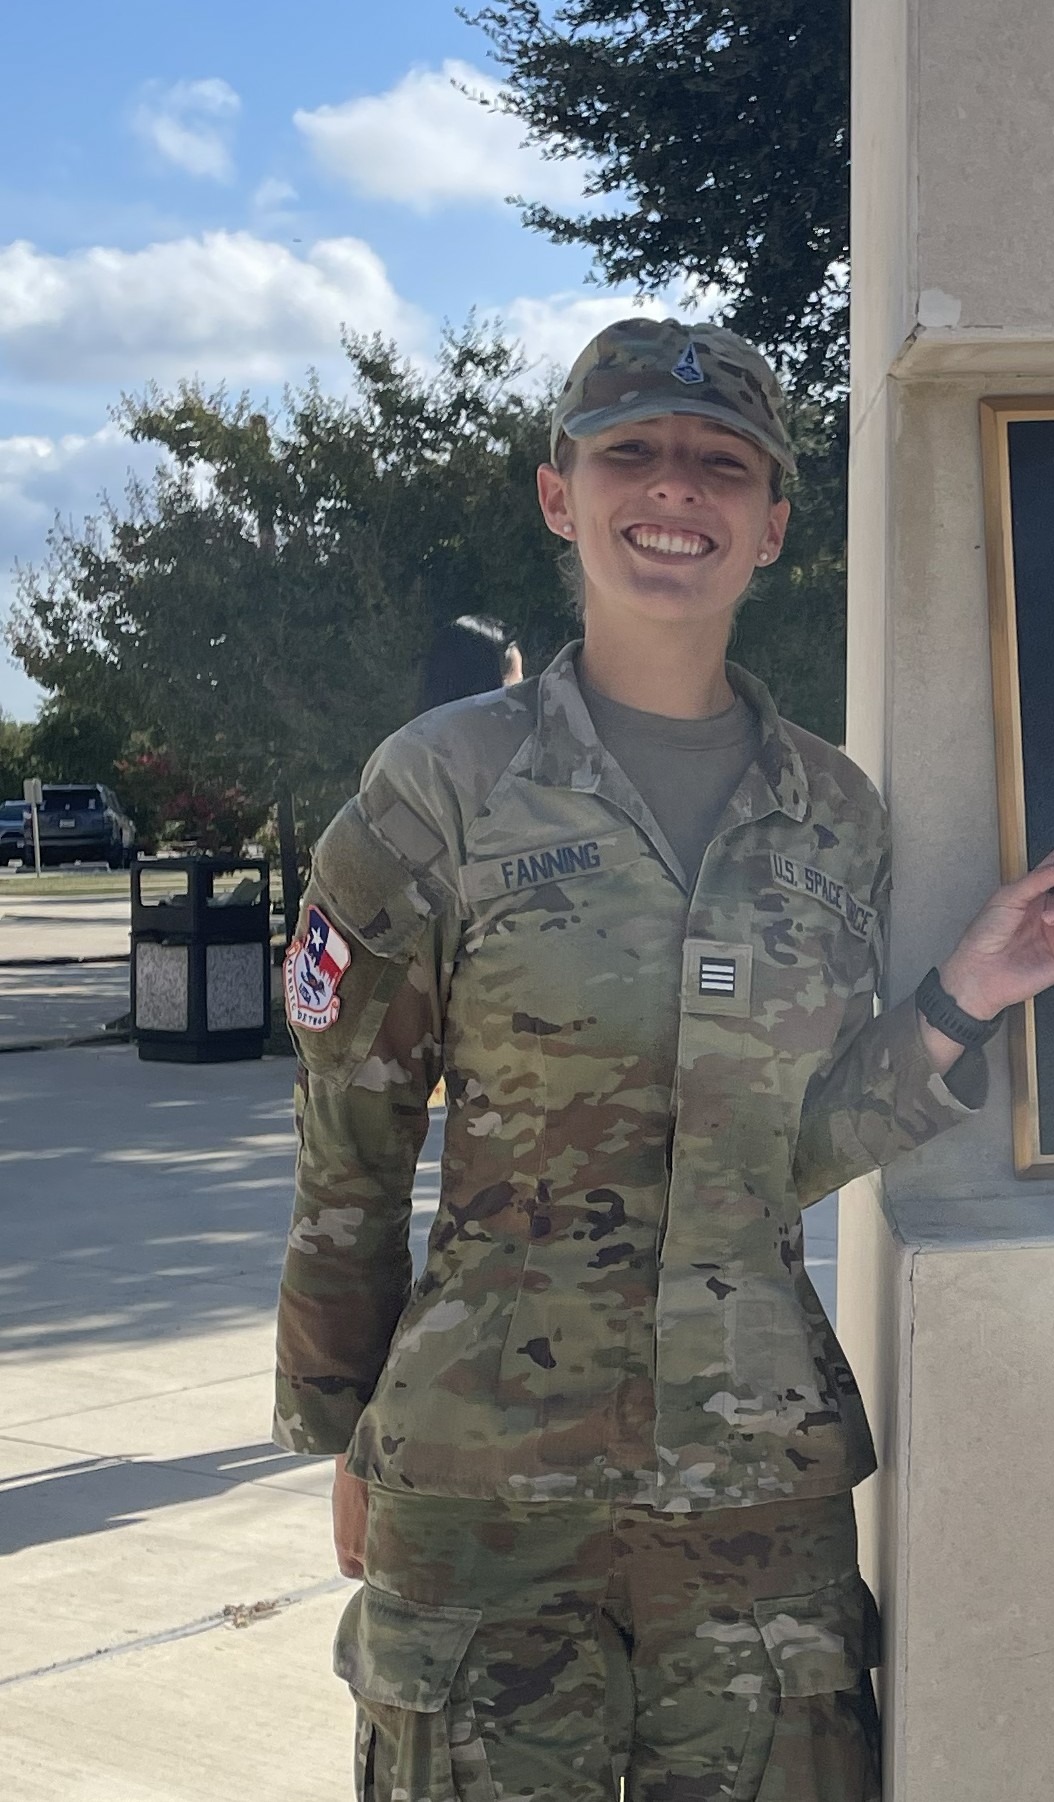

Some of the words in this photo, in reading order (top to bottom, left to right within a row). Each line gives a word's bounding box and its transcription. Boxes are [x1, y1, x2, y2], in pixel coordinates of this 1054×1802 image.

[501, 842, 600, 889] FANNING
[773, 853, 798, 887] U.S.
[804, 866, 843, 909] SPACE
[287, 958, 297, 1011] AFROTC
